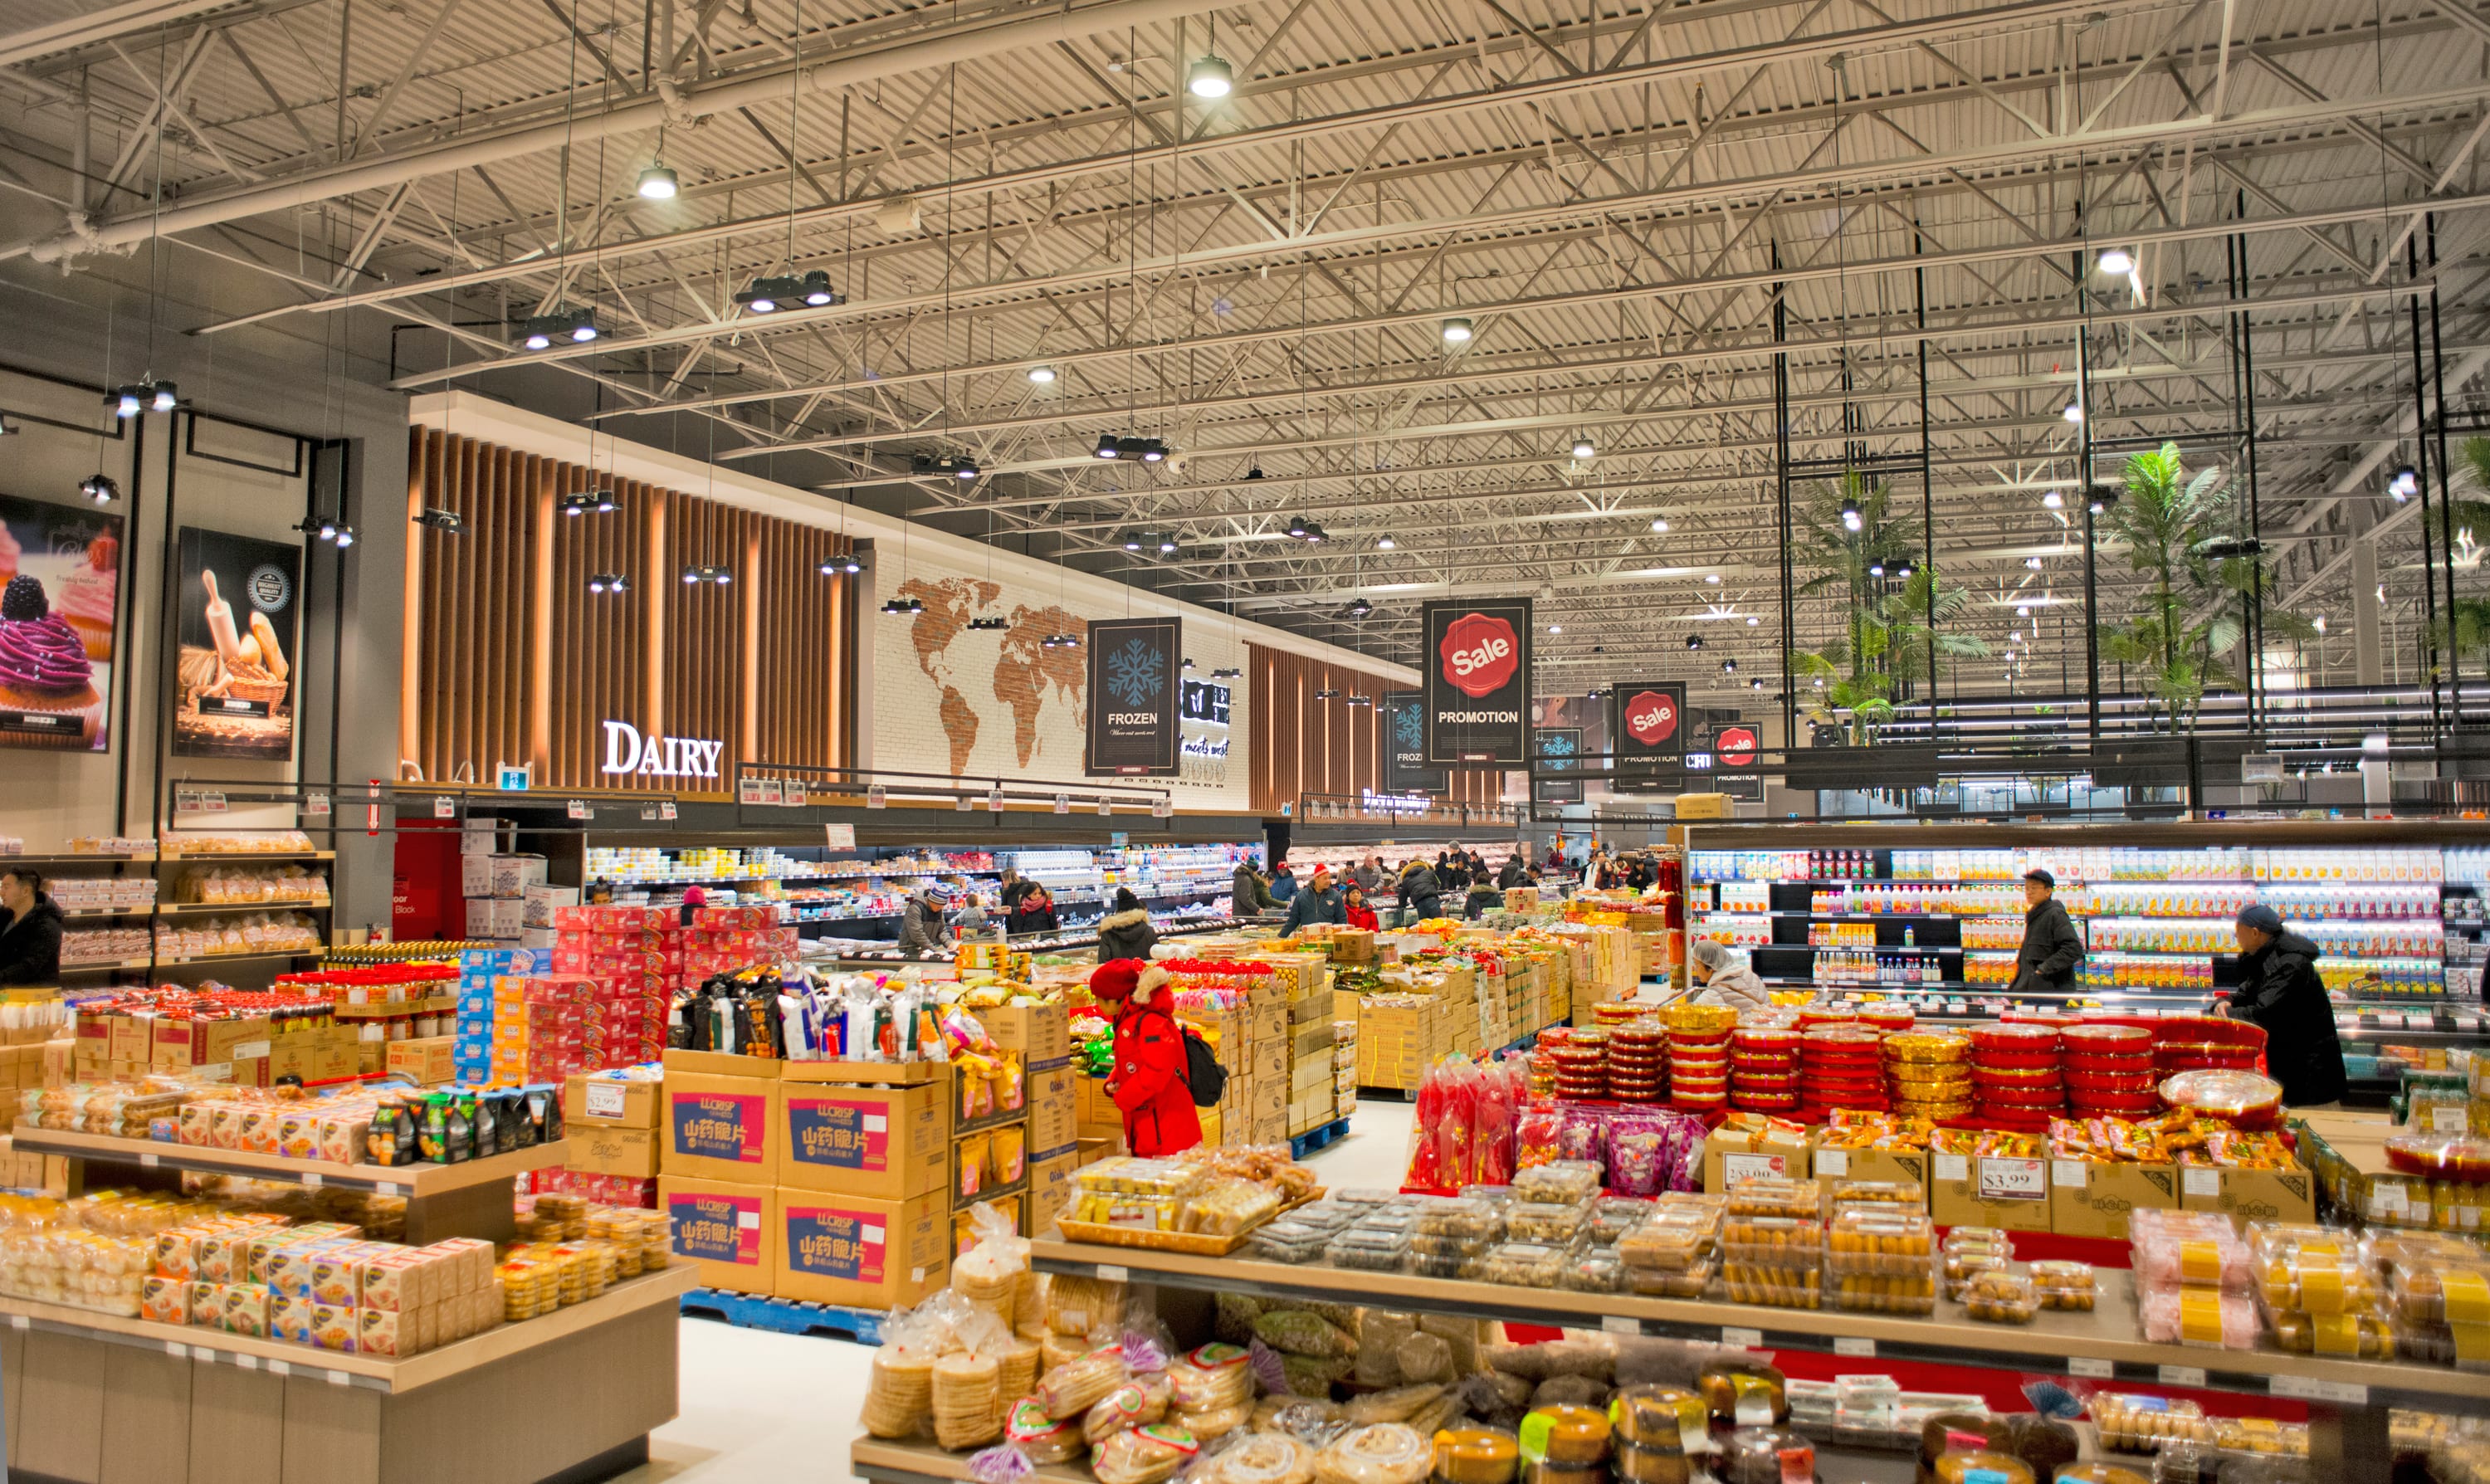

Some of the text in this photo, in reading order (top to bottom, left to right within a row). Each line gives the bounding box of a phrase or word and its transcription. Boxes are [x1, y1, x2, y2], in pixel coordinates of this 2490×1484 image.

[1452, 638, 1510, 676] Sale
[1108, 712, 1158, 725] FROZEN
[1438, 711, 1518, 723] PROMOTION
[1633, 706, 1672, 732] Sale
[1184, 737, 1209, 754] meets
[1397, 753, 1423, 761] FROZ
[395, 906, 415, 914] Block
[700, 1097, 736, 1111] LLCRISP
[817, 1103, 855, 1118] LLCRISP
[683, 1118, 748, 1145] 山药脆片
[802, 1125, 870, 1153] 山药脆片
[1984, 1174, 2030, 1188] $3.99
[2088, 1169, 2095, 1183] 1
[2220, 1173, 2227, 1187] 1
[817, 1212, 853, 1228] LLCRISP
[681, 1220, 745, 1247] 山药脆片
[799, 1234, 867, 1263] 山药脆片
